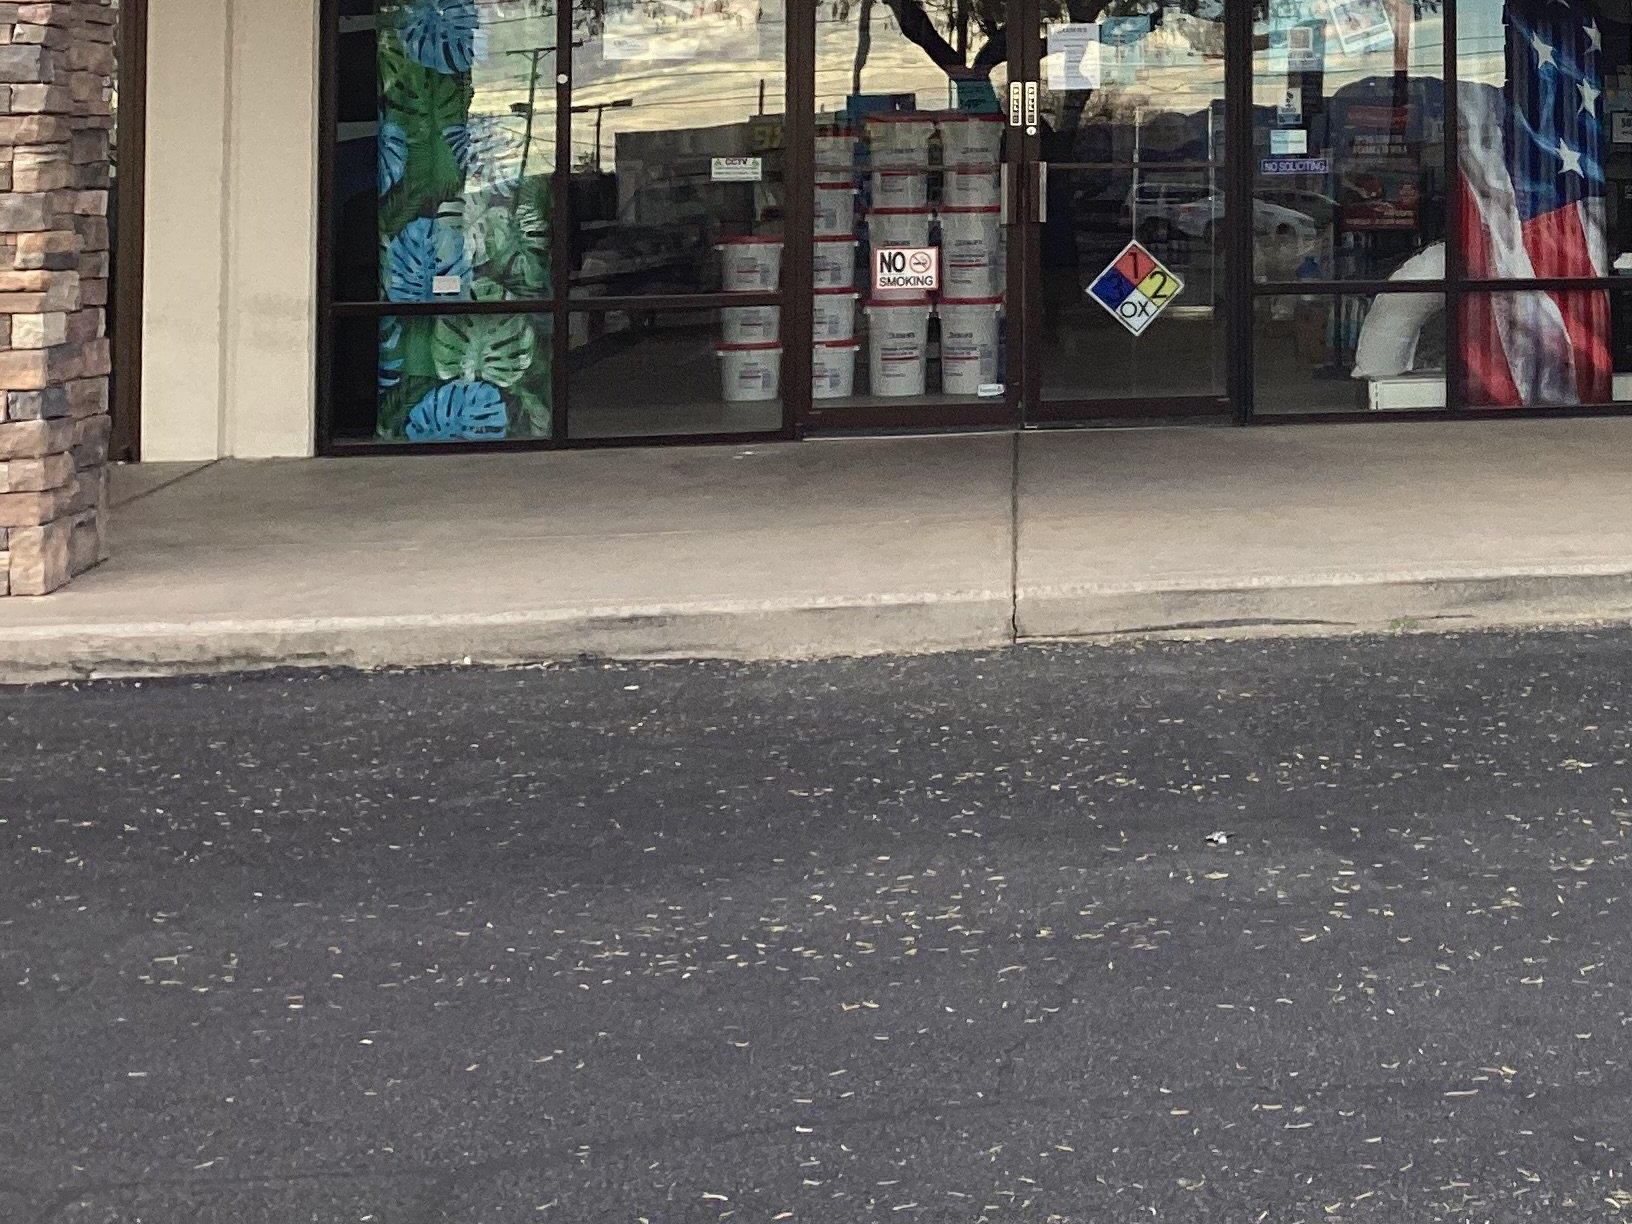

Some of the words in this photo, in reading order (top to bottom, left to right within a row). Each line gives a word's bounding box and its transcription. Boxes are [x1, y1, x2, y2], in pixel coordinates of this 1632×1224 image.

[1264, 161, 1278, 172] NO
[879, 251, 906, 274] NO
[1129, 251, 1139, 280] 1
[878, 275, 934, 288] SMOKING
[1148, 270, 1168, 299] 2
[1119, 300, 1150, 318] OX
